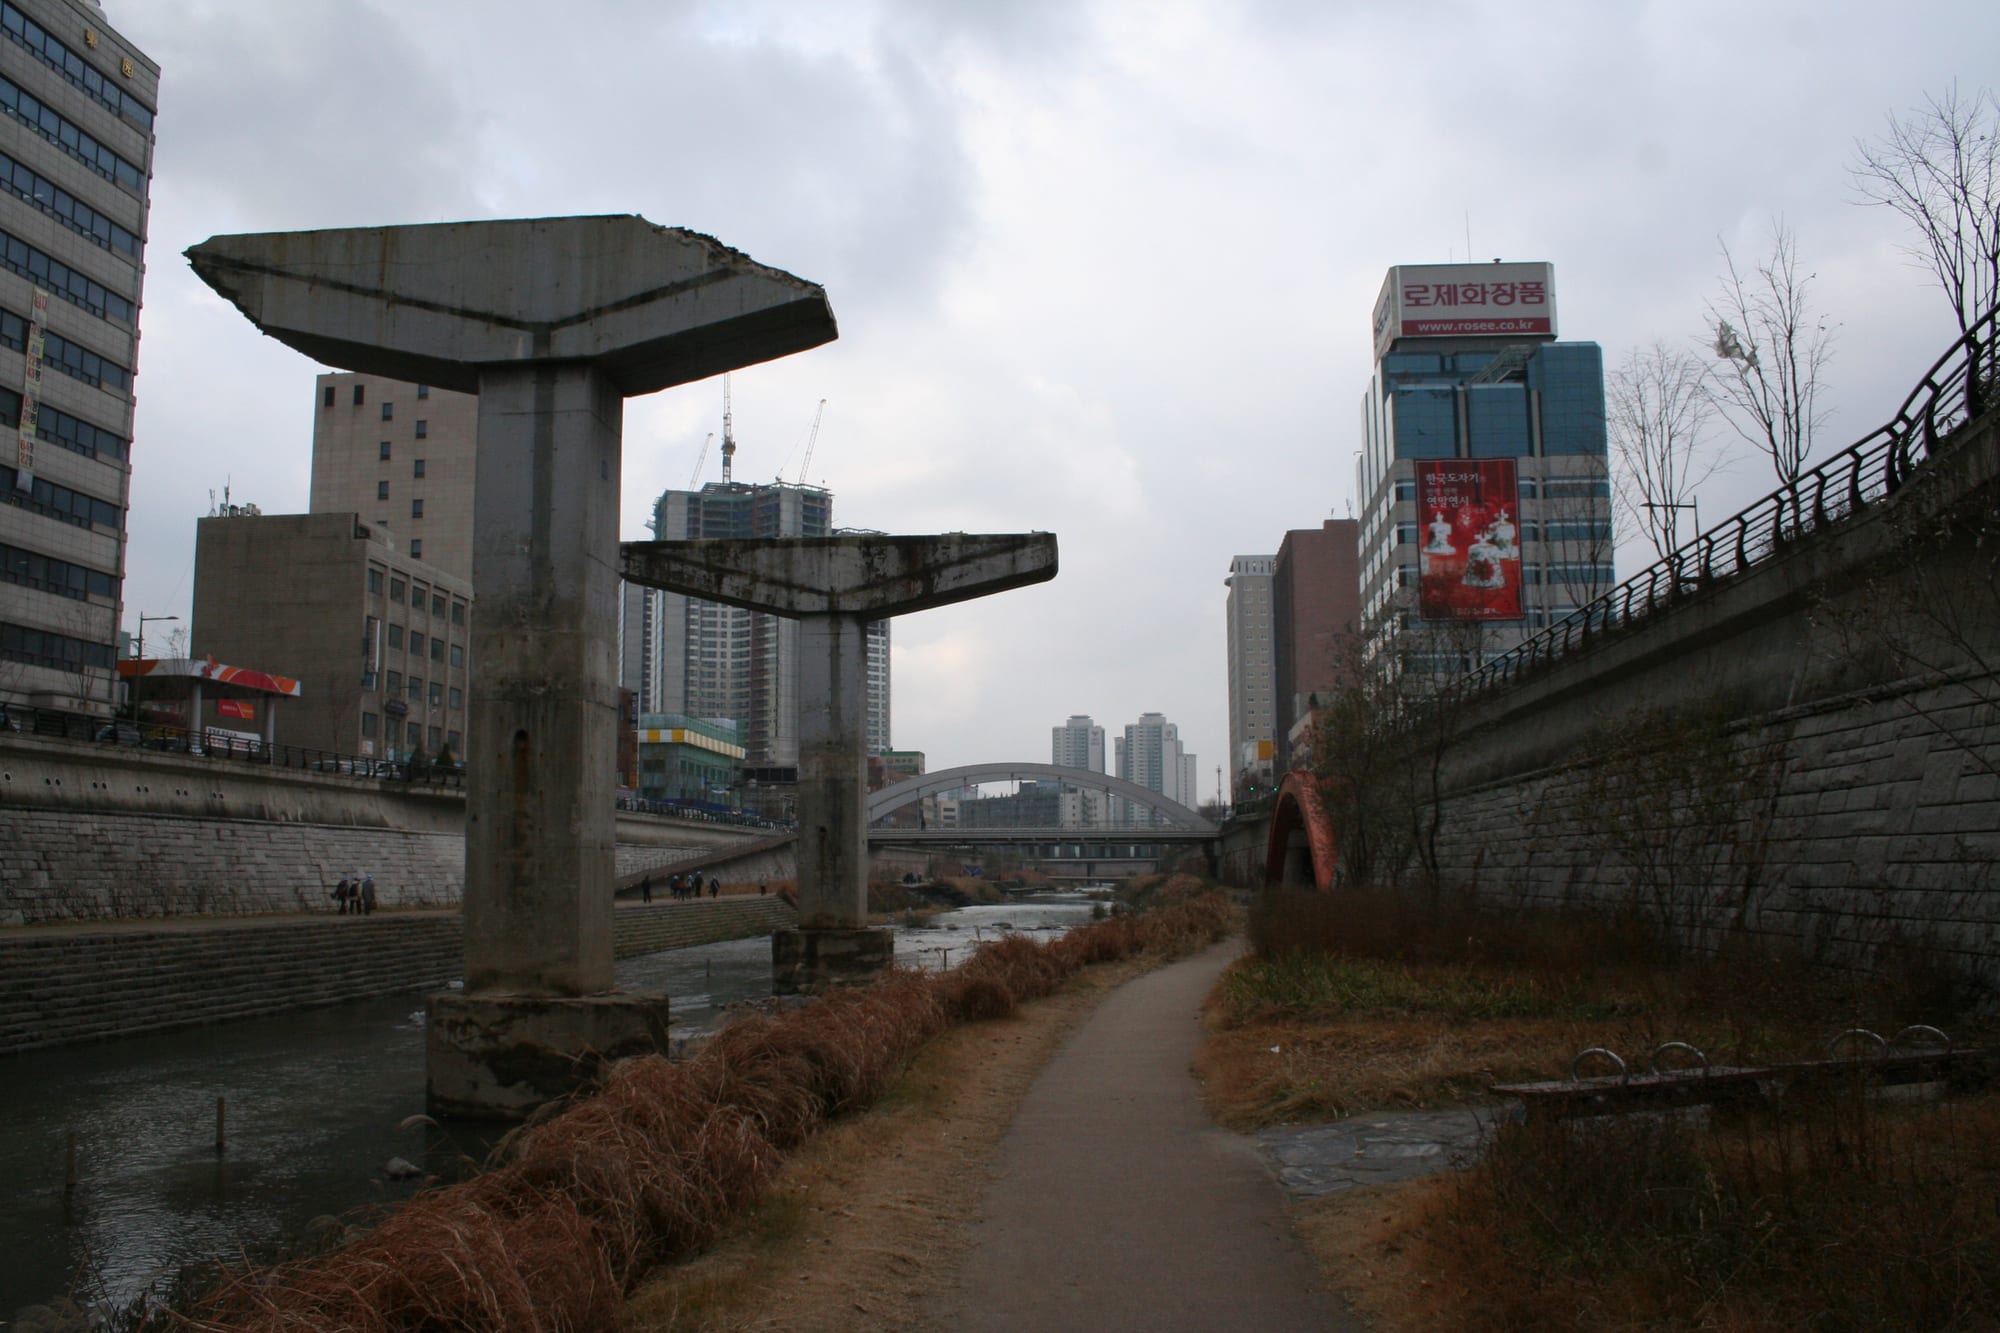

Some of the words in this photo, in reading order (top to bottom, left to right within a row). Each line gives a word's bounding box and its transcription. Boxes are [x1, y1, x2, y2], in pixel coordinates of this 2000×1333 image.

[1404, 281, 1545, 307] 로제화장품
[1418, 320, 1534, 332] www.rosee.co.kr
[1426, 495, 1469, 508] 연말연시
